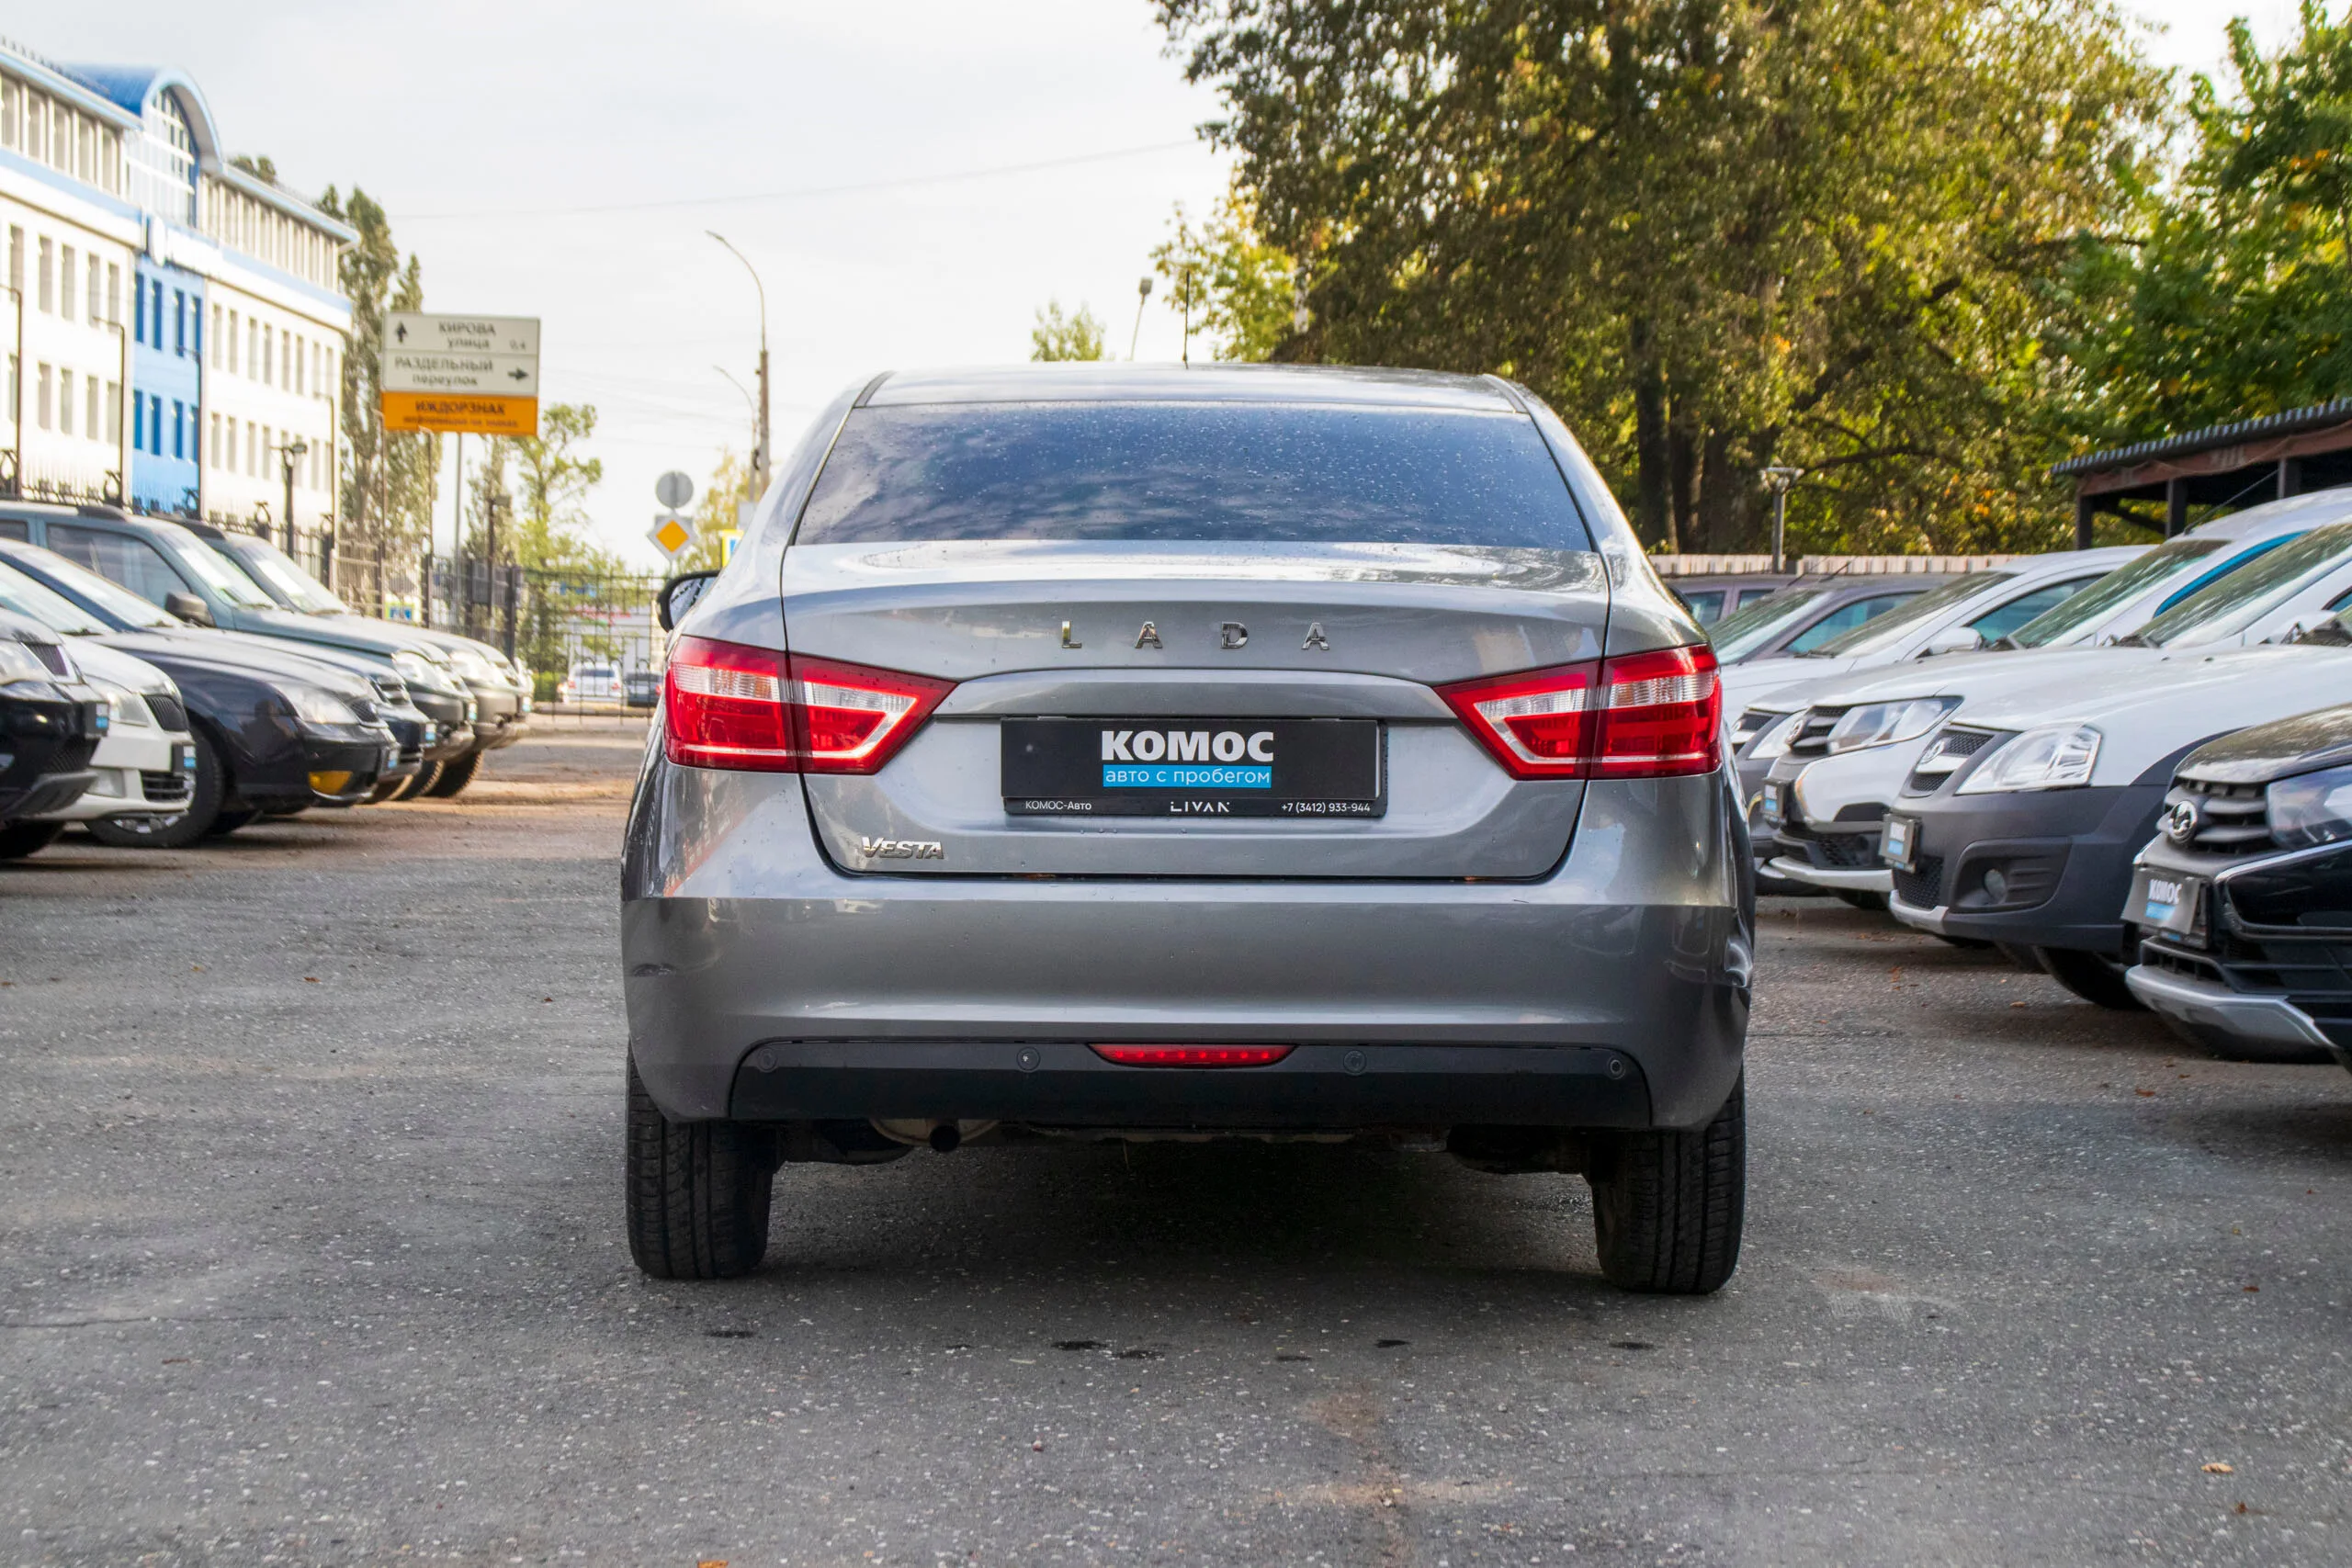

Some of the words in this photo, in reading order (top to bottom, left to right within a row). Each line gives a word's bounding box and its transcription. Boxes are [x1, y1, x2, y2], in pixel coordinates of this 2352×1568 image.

[438, 321, 496, 336] КИРОВА
[447, 337, 490, 349] улица
[394, 355, 493, 372] РАЗДЕЛЬНЫЙ
[413, 374, 478, 386] переулок
[1062, 620, 1330, 650] LADA
[1102, 730, 1274, 762] КОМОС
[1105, 771, 1149, 783] авто
[1157, 771, 1168, 783] с
[1173, 768, 1270, 785] пробегом
[1025, 800, 1092, 810] КОМОС-Авто
[1170, 801, 1230, 813] LIVAN
[1281, 802, 1294, 812] +7
[1295, 801, 1326, 814] (3412)
[1329, 802, 1371, 813] 933-944
[862, 836, 944, 860] VESTA
